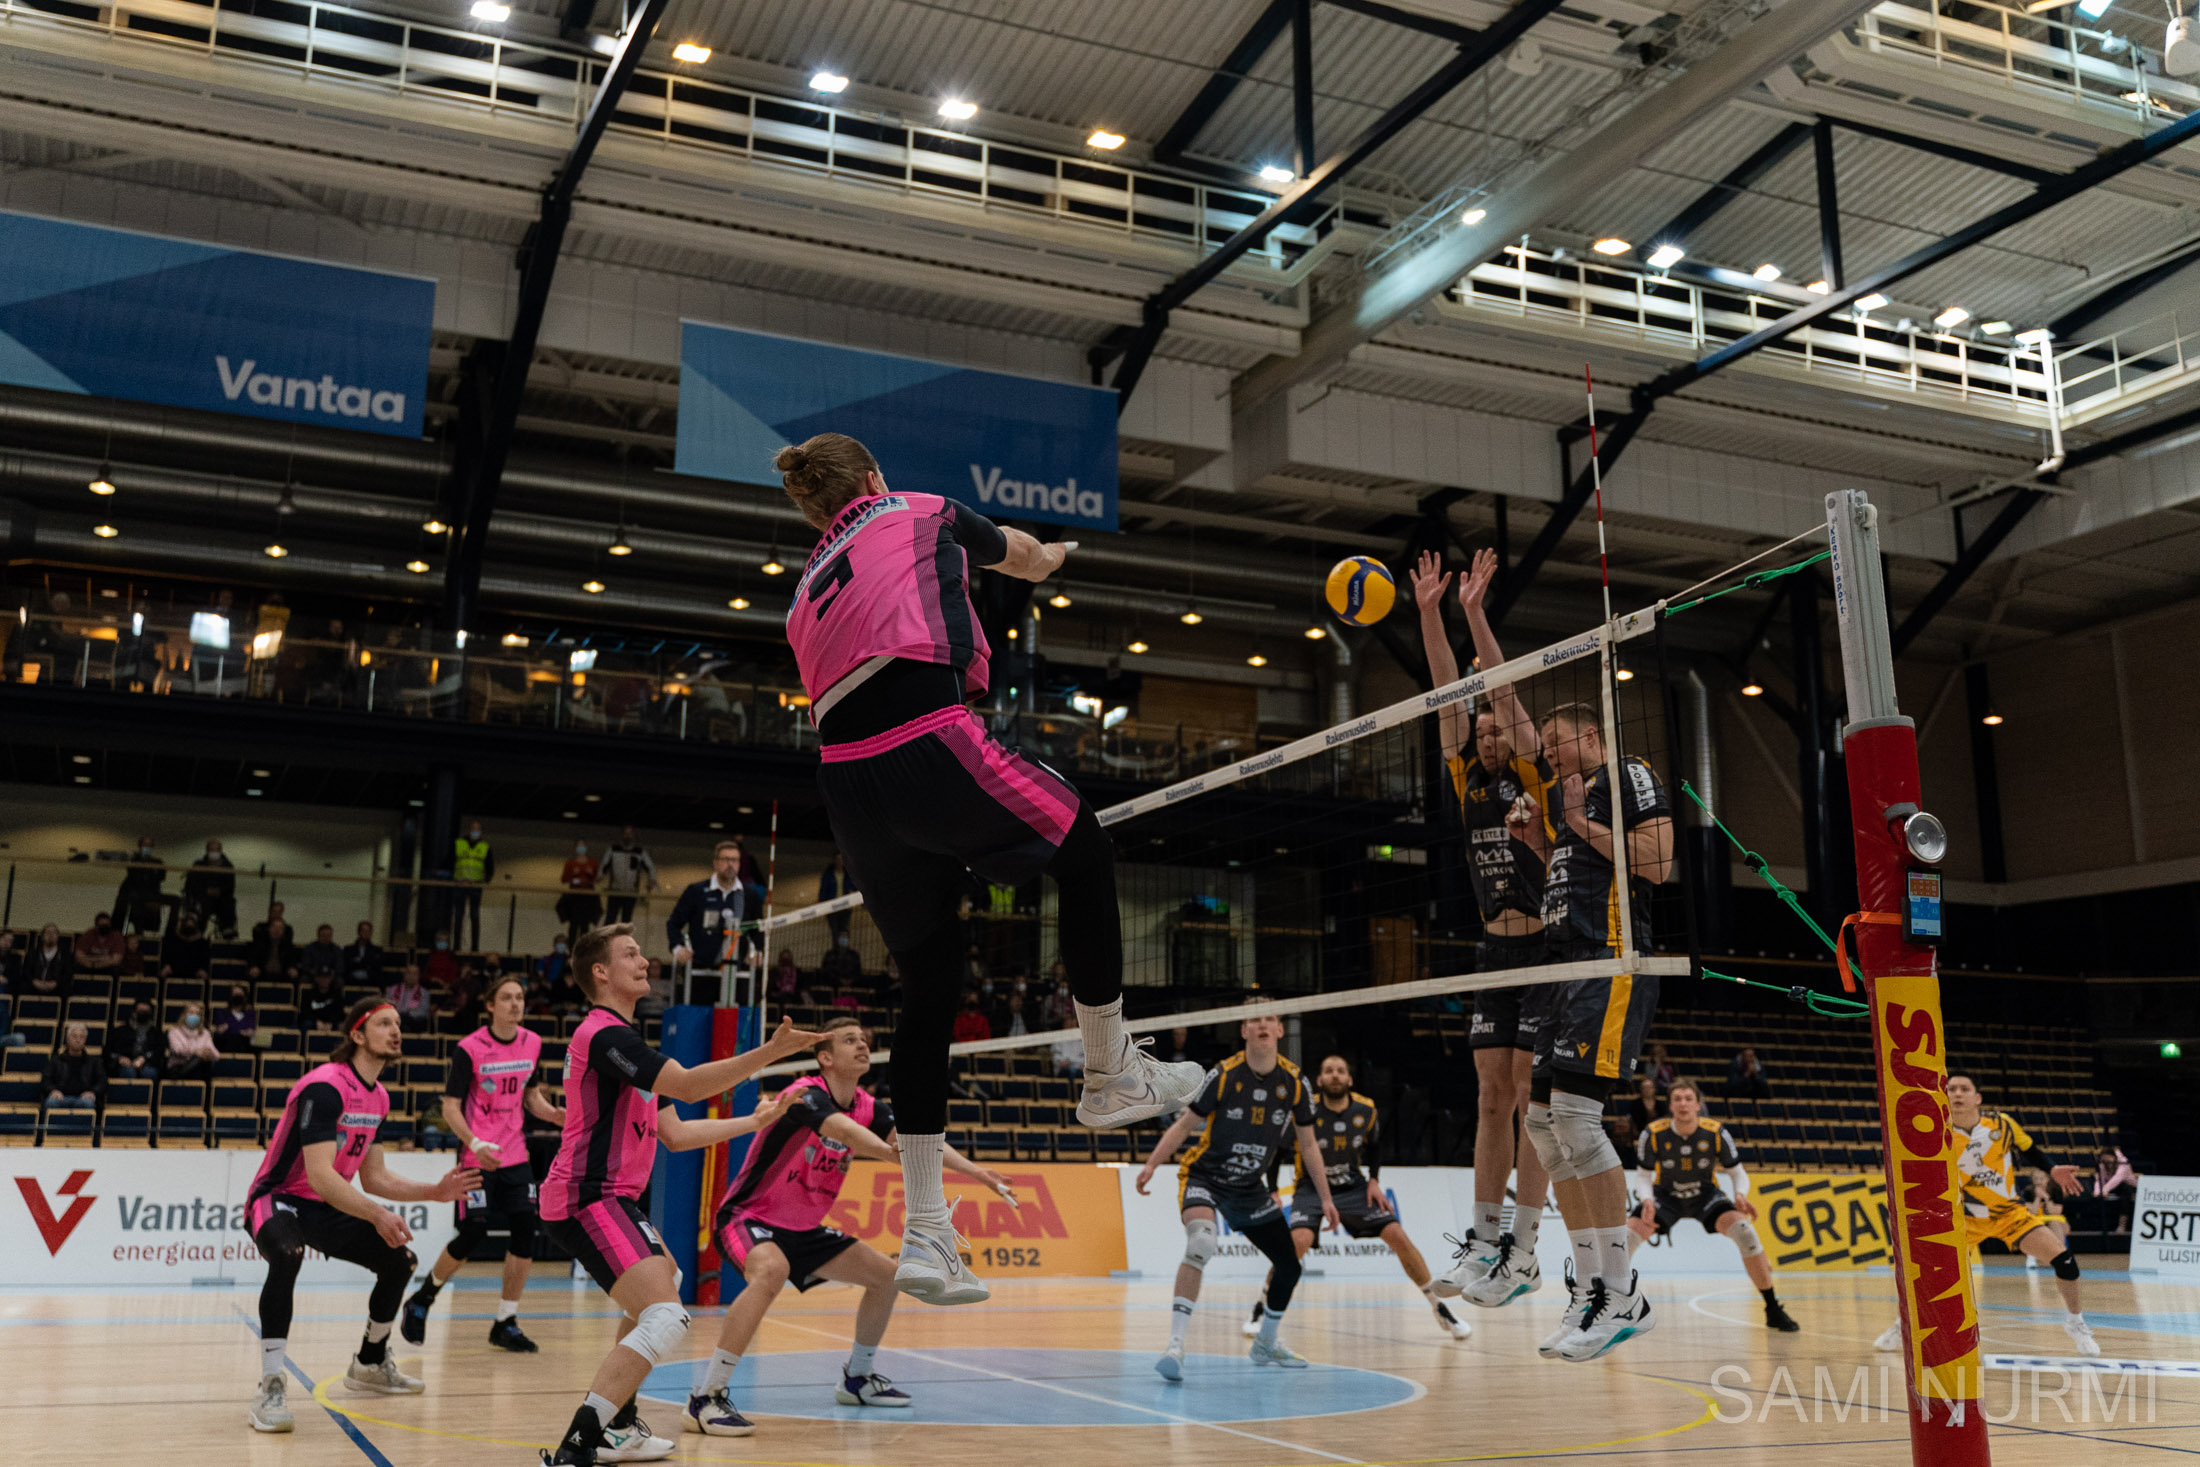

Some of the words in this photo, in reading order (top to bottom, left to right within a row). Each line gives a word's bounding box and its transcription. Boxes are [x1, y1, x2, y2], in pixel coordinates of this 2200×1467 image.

[215, 355, 406, 423] Vantaa
[969, 464, 1105, 520] Vanda
[1425, 676, 1486, 709] Rakennuslehti
[1325, 716, 1377, 747] Rakennuslehti
[1239, 751, 1284, 776] Rakennuslehti
[1165, 779, 1205, 802] Rakennuslehti
[501, 1076, 518, 1095] 10
[1250, 1106, 1265, 1125] 13
[1886, 1002, 1979, 1369] SJÖMAN
[2140, 1210, 2200, 1242] SRT
[113, 1241, 215, 1266] energiaa
[981, 1248, 1041, 1266] 1952
